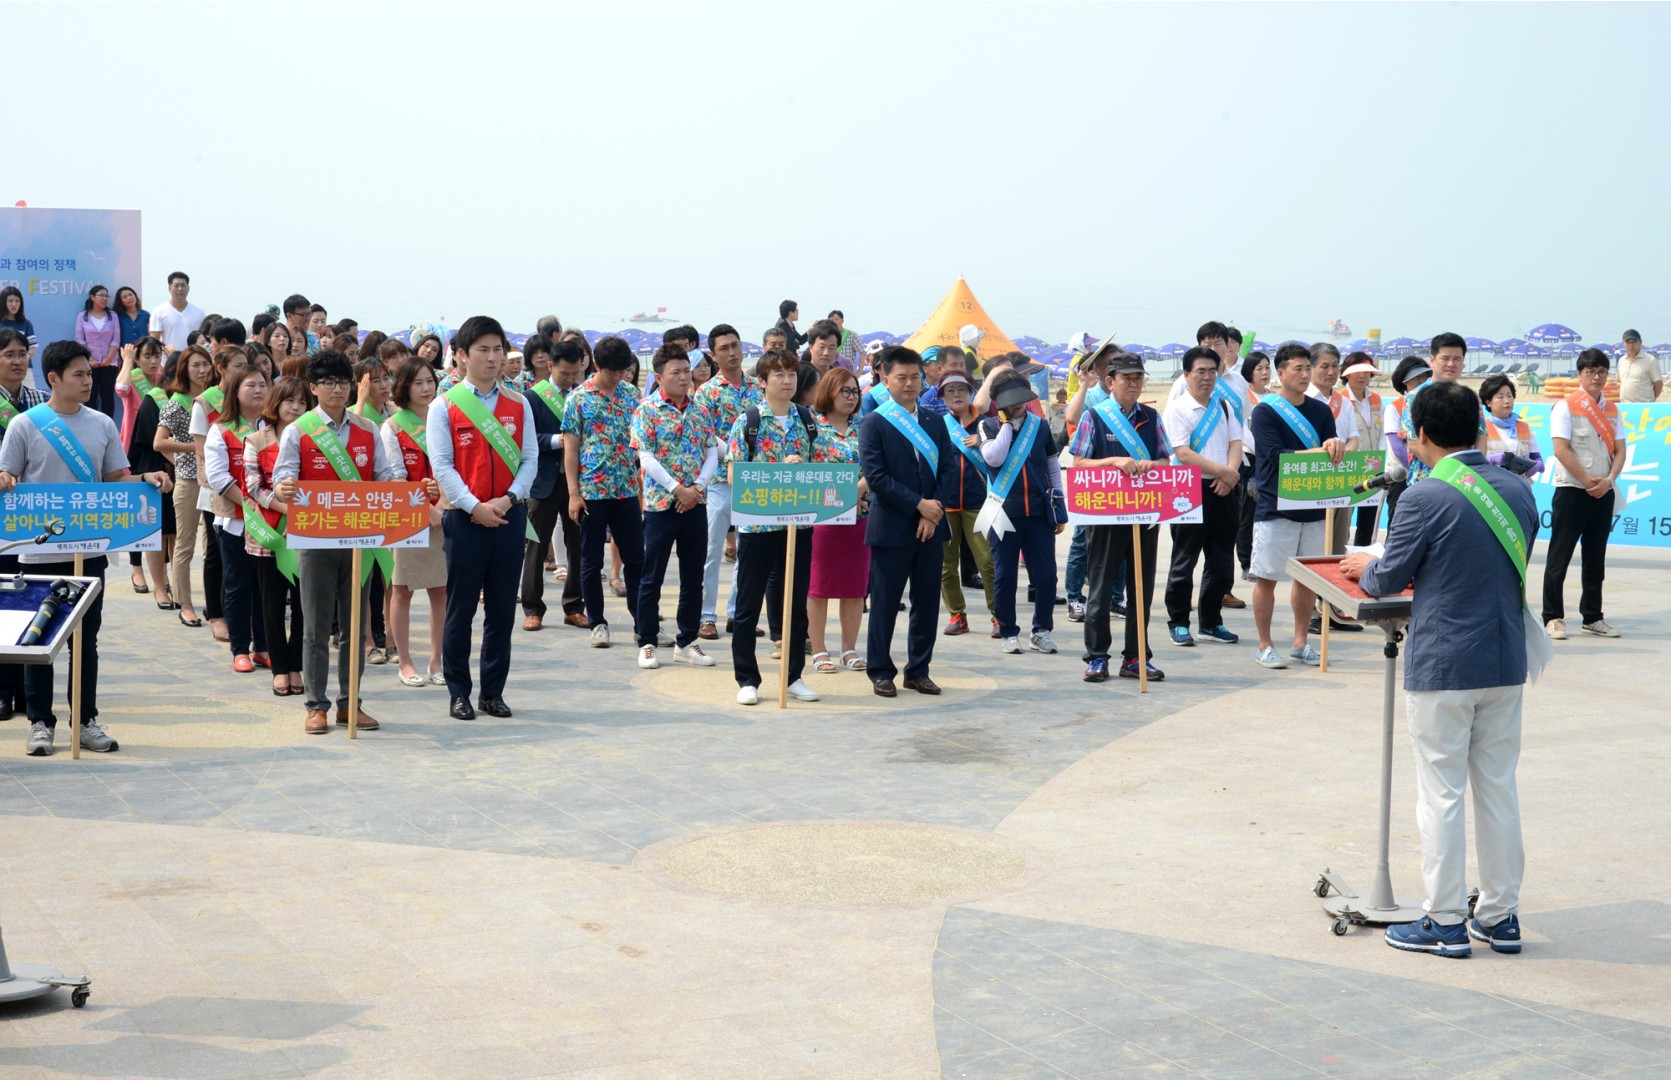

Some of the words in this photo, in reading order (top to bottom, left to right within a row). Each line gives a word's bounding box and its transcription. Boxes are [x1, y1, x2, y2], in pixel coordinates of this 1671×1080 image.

[16, 259, 49, 271] 참여의
[54, 259, 76, 271] 정책
[1282, 462, 1308, 475] 올여름
[1310, 461, 1335, 473] 최고의
[1337, 460, 1357, 472] 순간!
[740, 470, 771, 483] 우리는
[773, 471, 793, 483] 지금
[795, 471, 834, 484] 해운대로
[835, 471, 855, 484] 간다
[1074, 469, 1123, 489] 싸니까
[1129, 468, 1194, 489] 많으니까
[1282, 476, 1322, 492] 해운대와
[1325, 475, 1345, 490] 함께
[3, 492, 65, 510] 함께하는
[69, 491, 134, 509] 유통산업,
[317, 491, 361, 509] 메르스
[365, 491, 404, 509] 안녕~
[739, 488, 820, 507] 쇼핑하러~!!
[1075, 490, 1163, 510] 해운대니까!
[70, 512, 135, 529] 지역경제!
[294, 511, 340, 530] 휴가는
[343, 511, 422, 530] 해운대로~!!
